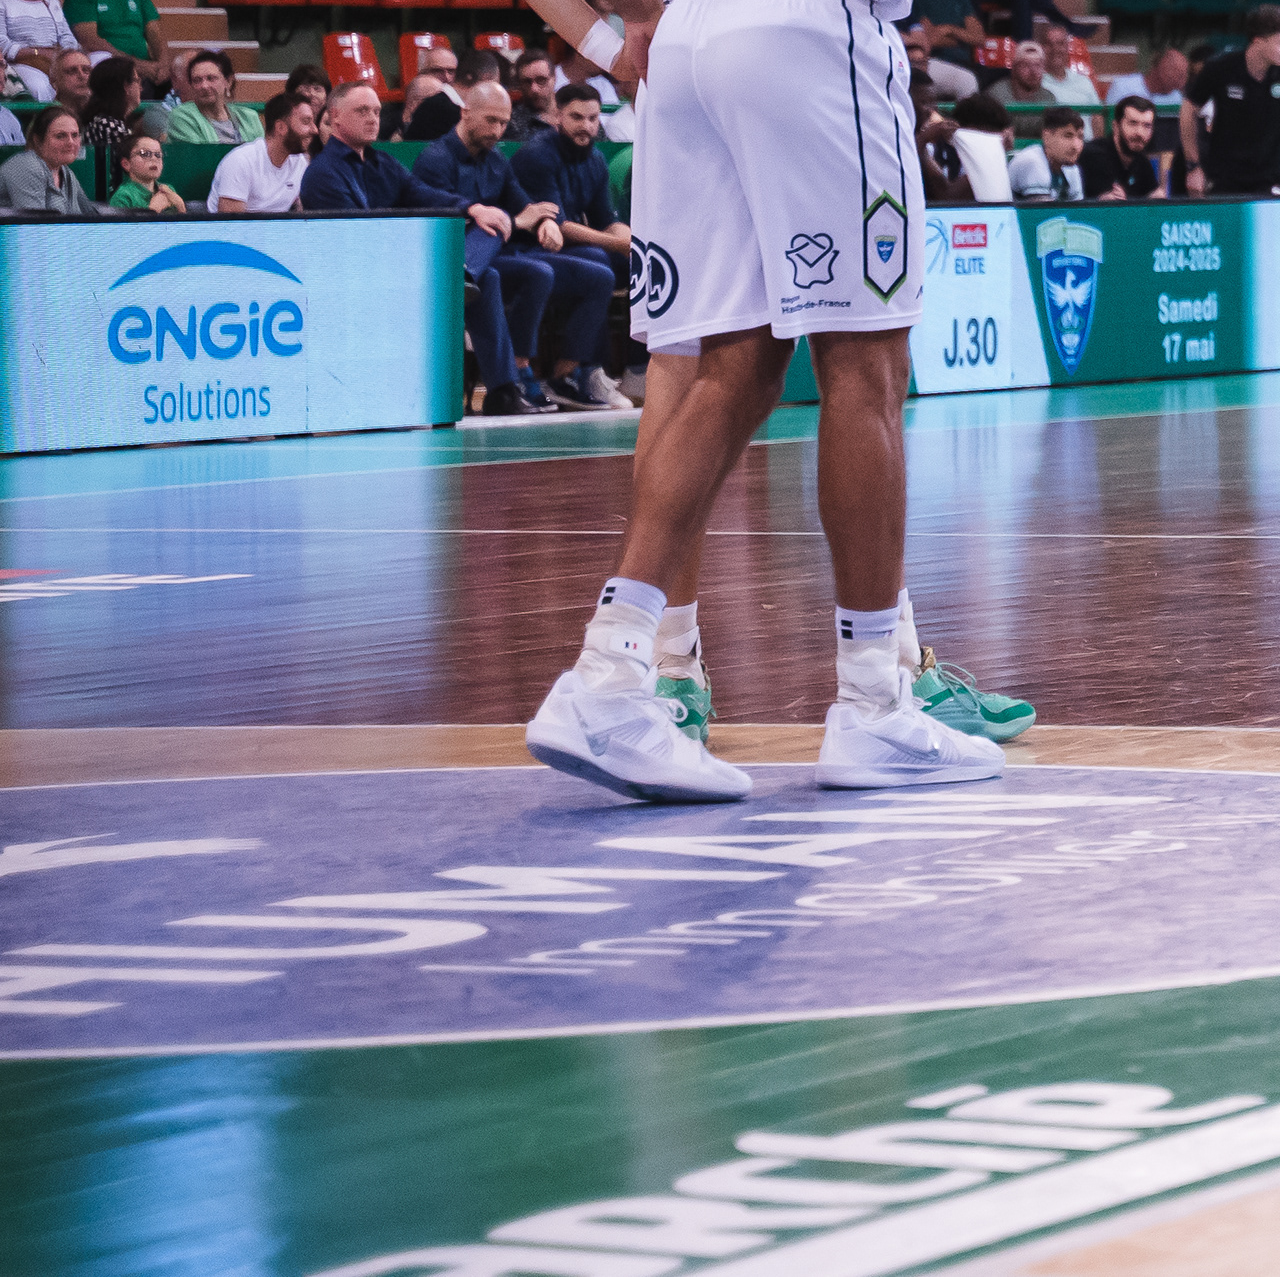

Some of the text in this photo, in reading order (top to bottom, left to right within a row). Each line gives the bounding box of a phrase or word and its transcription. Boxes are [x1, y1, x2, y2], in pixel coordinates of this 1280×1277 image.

[1161, 222, 1213, 246] SAISON
[954, 256, 986, 275] ELITE
[1153, 246, 1221, 272] 2024-2025
[1158, 290, 1219, 323] Samedi
[943, 316, 998, 368] J.30
[1162, 330, 1216, 363] 17 mai
[144, 379, 272, 424] Solutions
